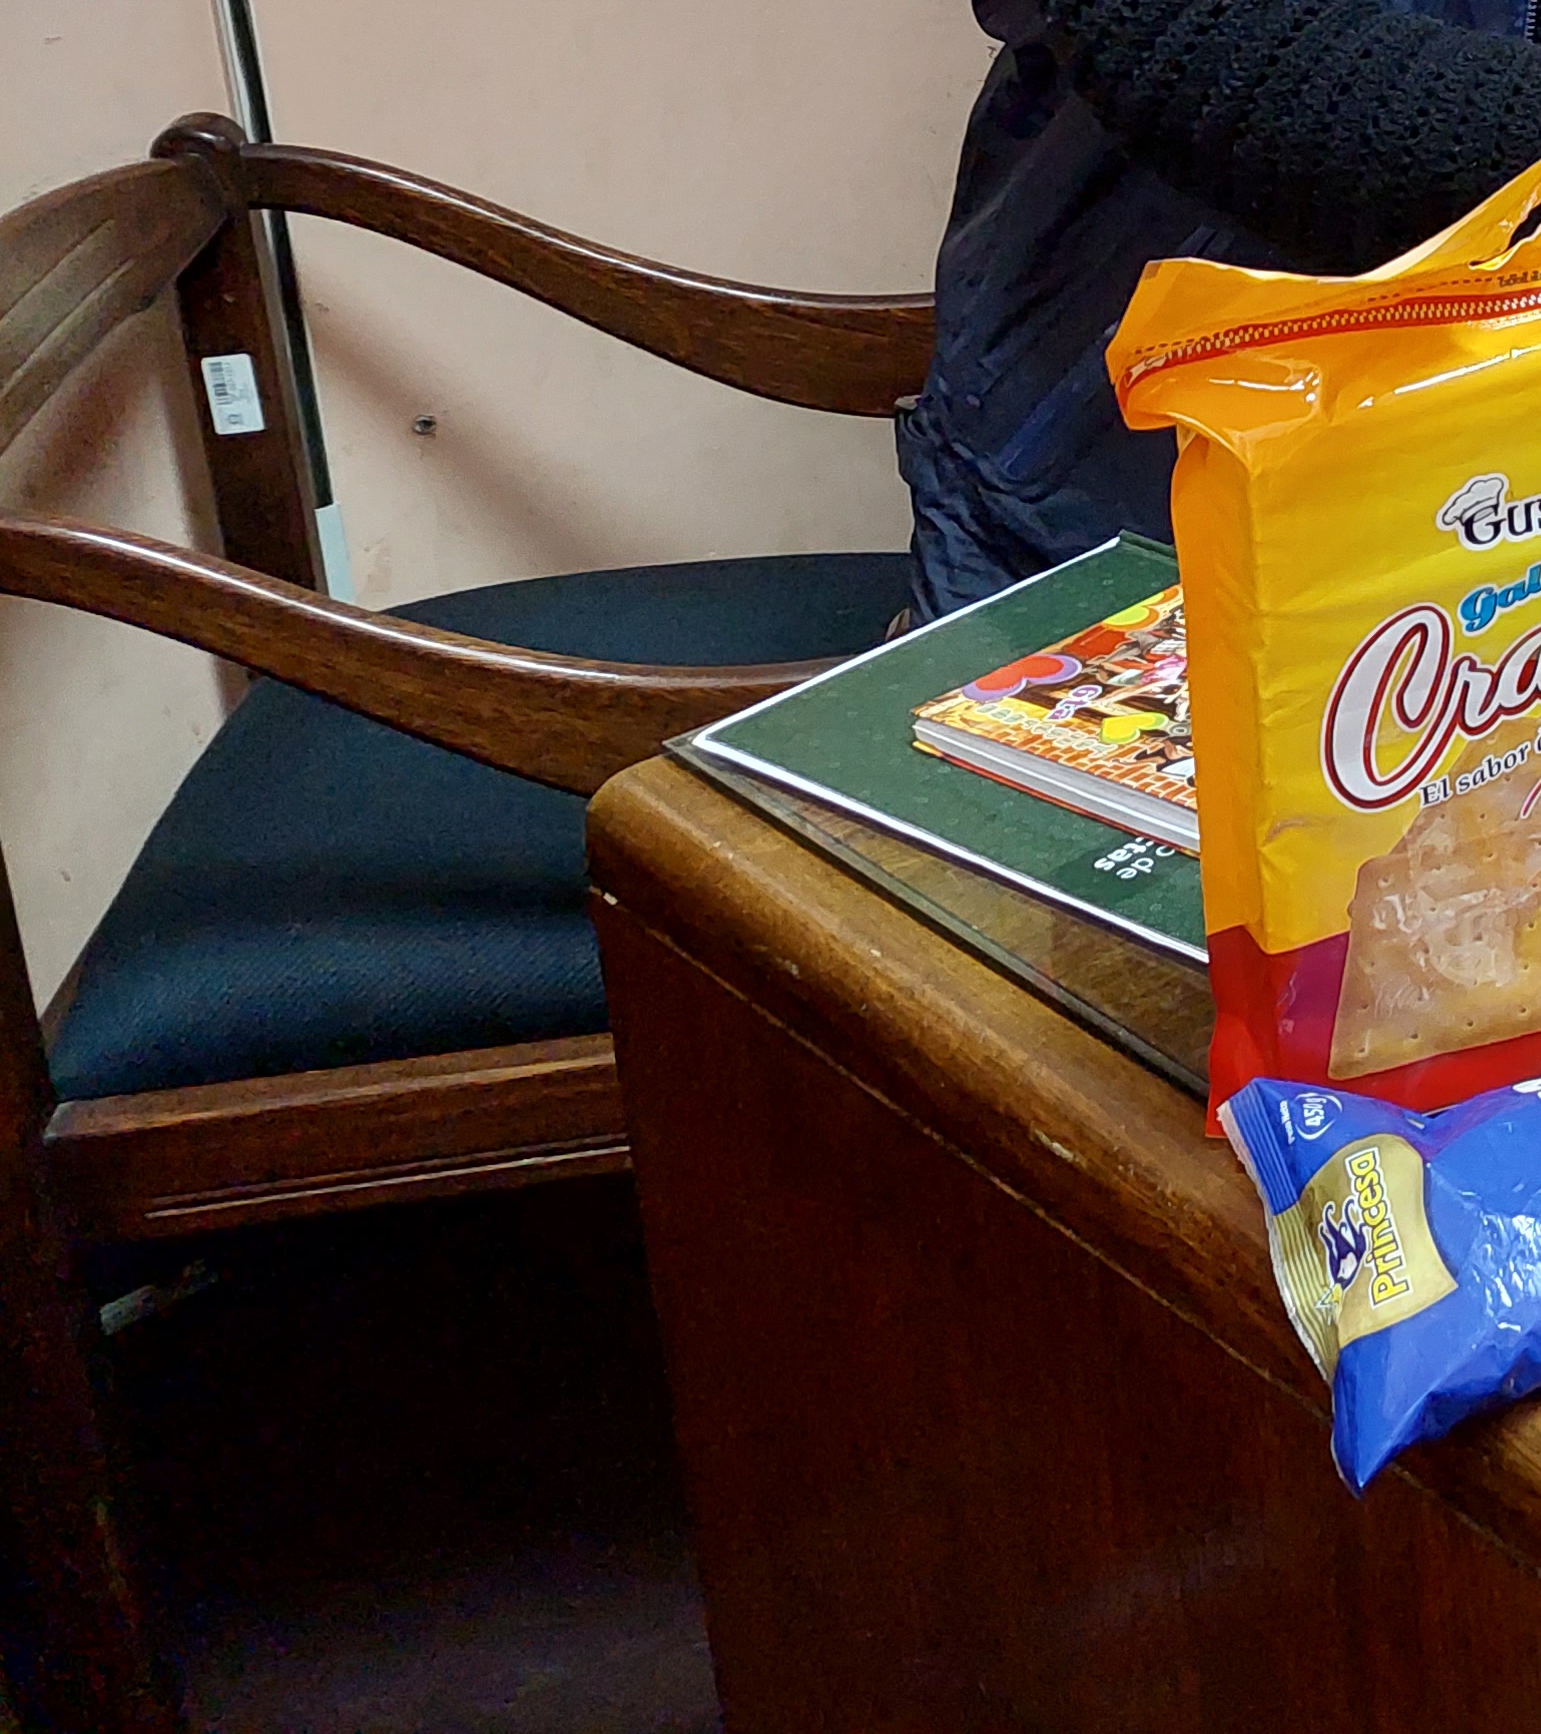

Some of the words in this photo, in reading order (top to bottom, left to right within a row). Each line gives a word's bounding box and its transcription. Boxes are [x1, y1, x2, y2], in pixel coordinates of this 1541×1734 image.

[1421, 779, 1451, 807] El
[1456, 748, 1529, 796] sabor
[1116, 856, 1154, 879] de
[1302, 1097, 1328, 1127] 450g
[1349, 1148, 1412, 1307] Princesa
